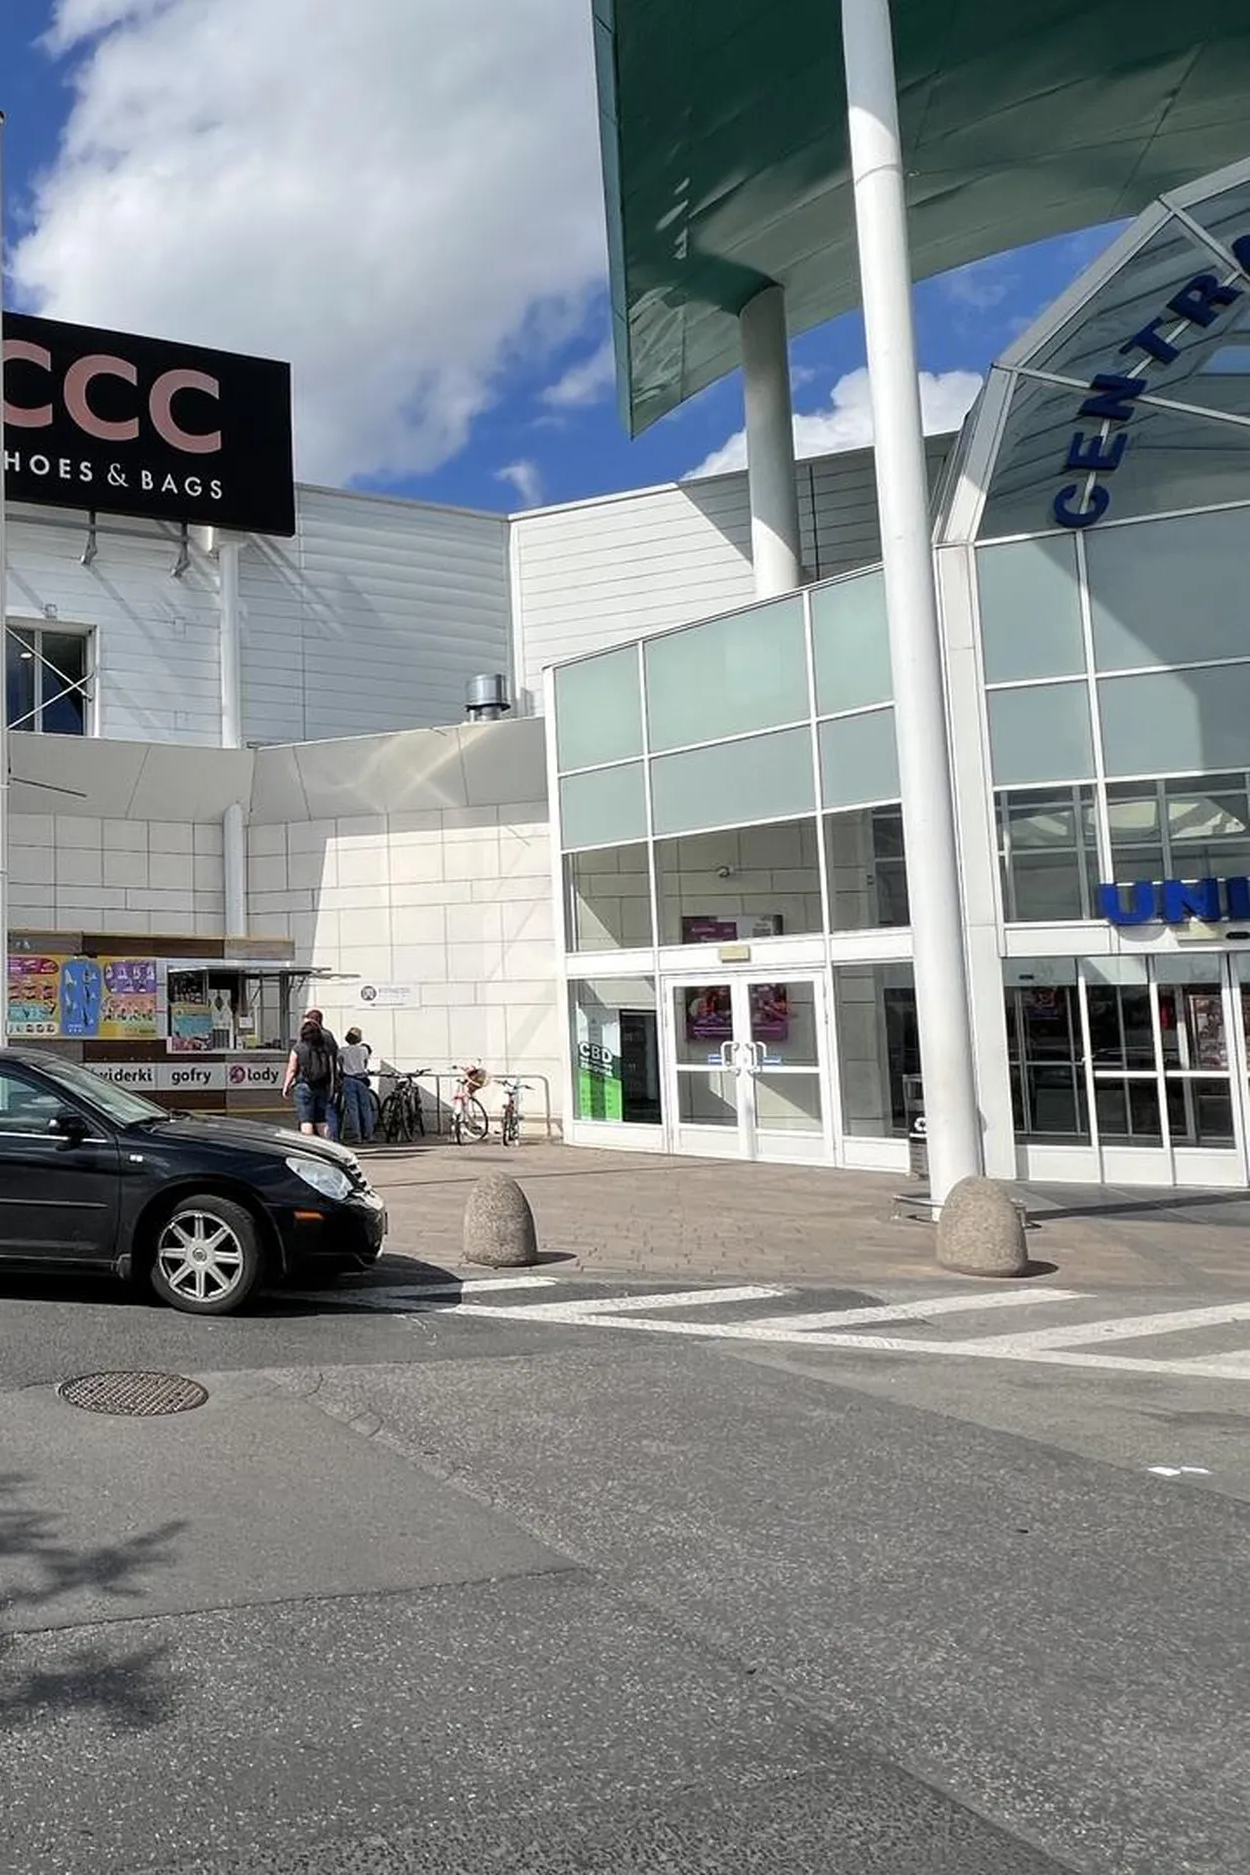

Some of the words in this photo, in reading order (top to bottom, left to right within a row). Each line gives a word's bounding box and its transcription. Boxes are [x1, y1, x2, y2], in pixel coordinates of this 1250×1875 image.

[107, 463, 129, 487] &
[141, 470, 222, 499] BAGS
[579, 1042, 613, 1063] CBD
[171, 1067, 212, 1086] gofry
[247, 1067, 279, 1082] lody
